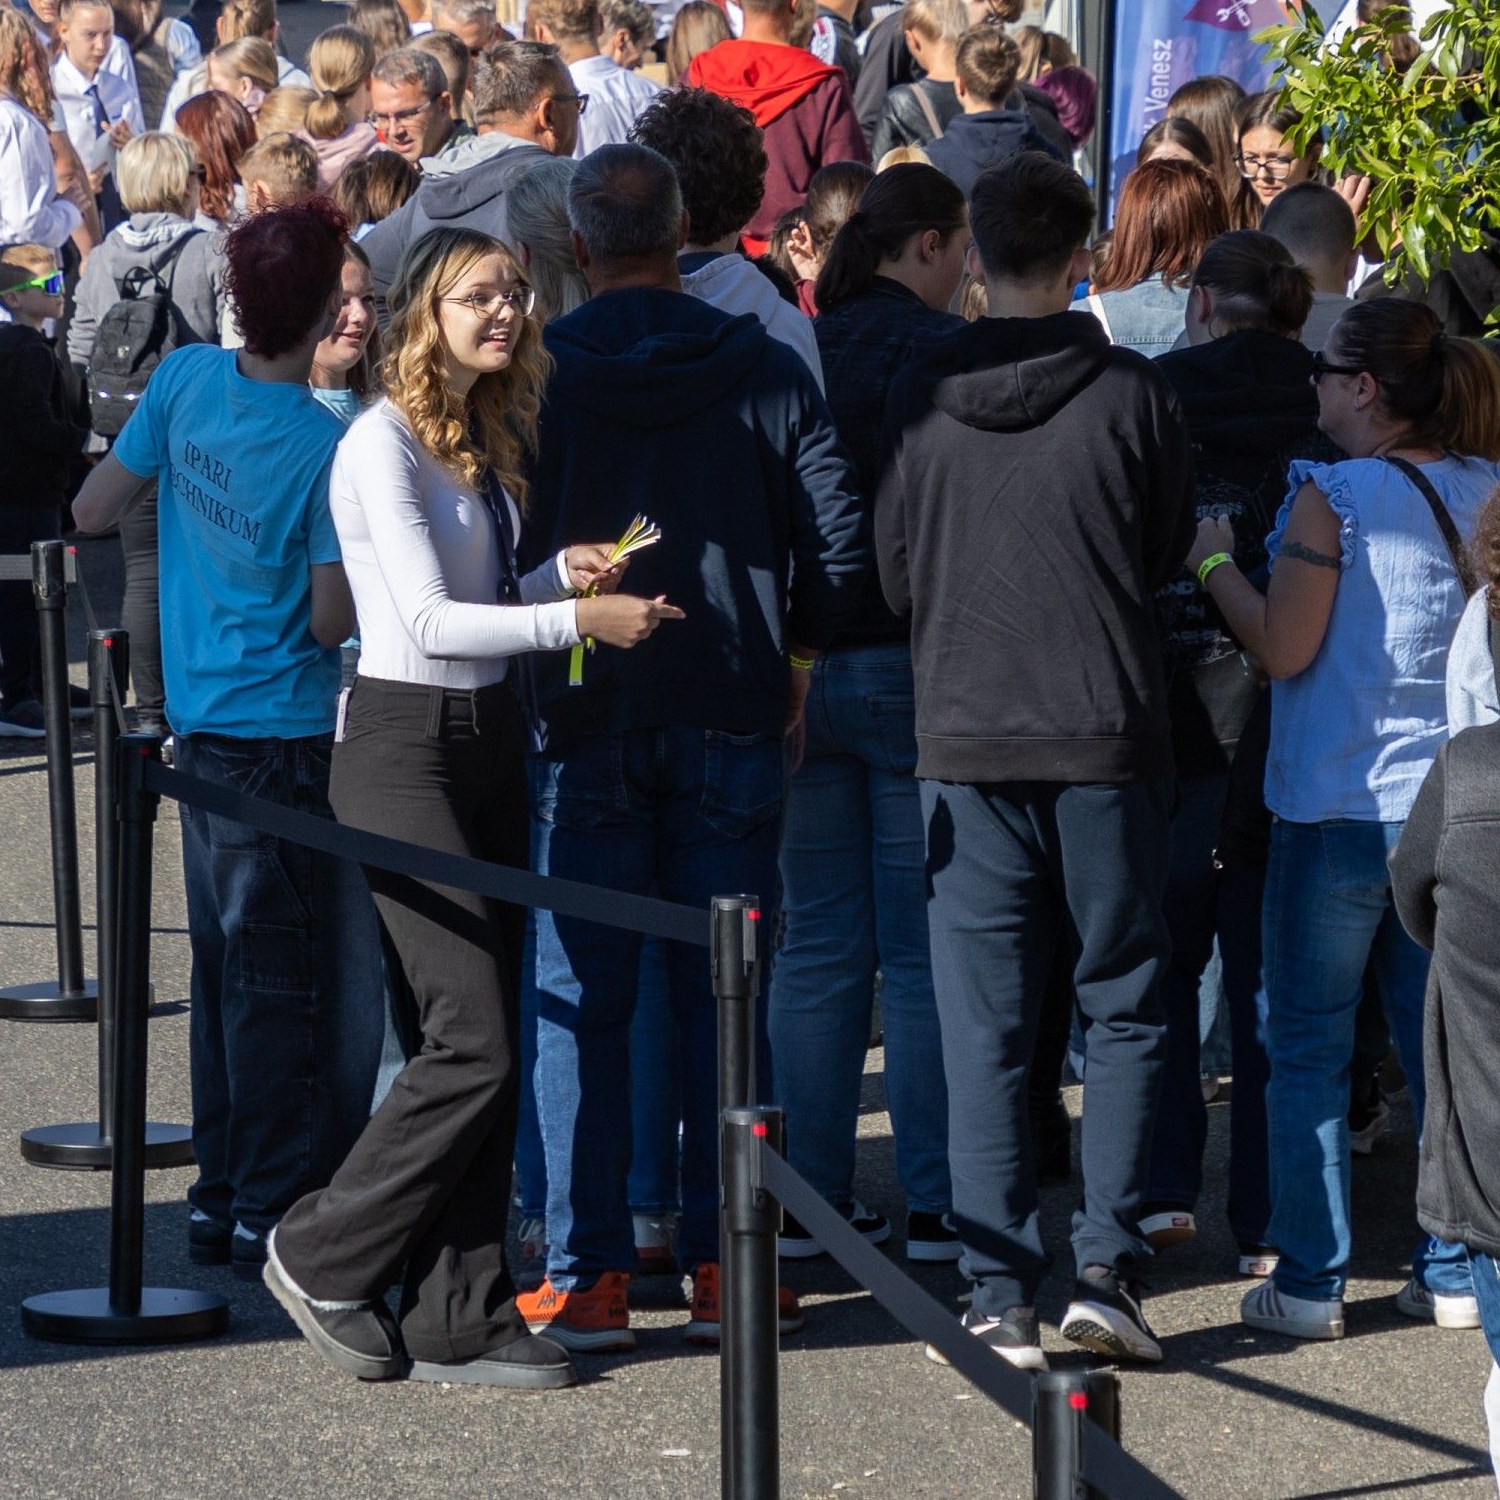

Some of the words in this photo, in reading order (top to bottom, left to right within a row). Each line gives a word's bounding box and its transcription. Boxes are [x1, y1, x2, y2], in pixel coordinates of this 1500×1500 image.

[1143, 38, 1173, 113] Venesz
[169, 461, 262, 546] ECHNIKUM
[183, 439, 233, 493] IPARI
